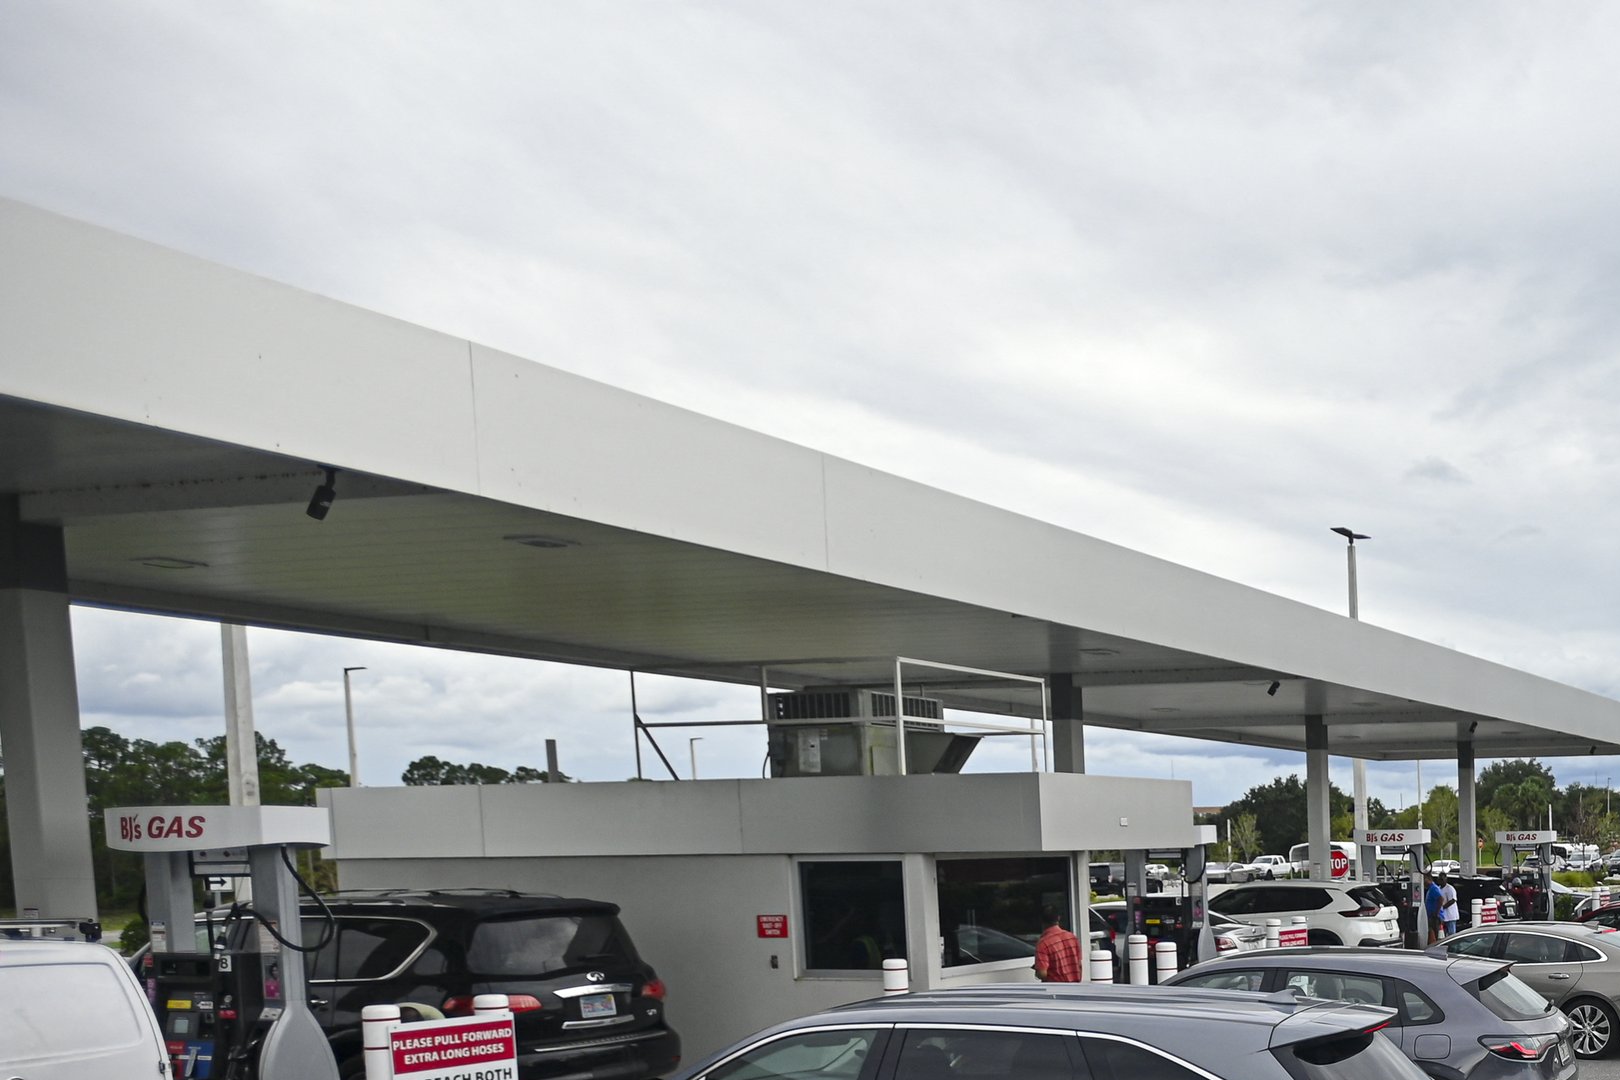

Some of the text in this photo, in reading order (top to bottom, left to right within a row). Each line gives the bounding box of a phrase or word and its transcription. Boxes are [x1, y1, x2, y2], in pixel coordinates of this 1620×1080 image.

[120, 814, 206, 842] BJ's GAS
[1366, 833, 1404, 843] BJ's GAS
[1518, 833, 1537, 841] GAS
[1330, 858, 1347, 870] TOP
[220, 957, 229, 969] 8
[392, 1028, 512, 1051] PLEASE PULL FORWARD
[404, 1043, 504, 1065] EXTRA LONG HOSES
